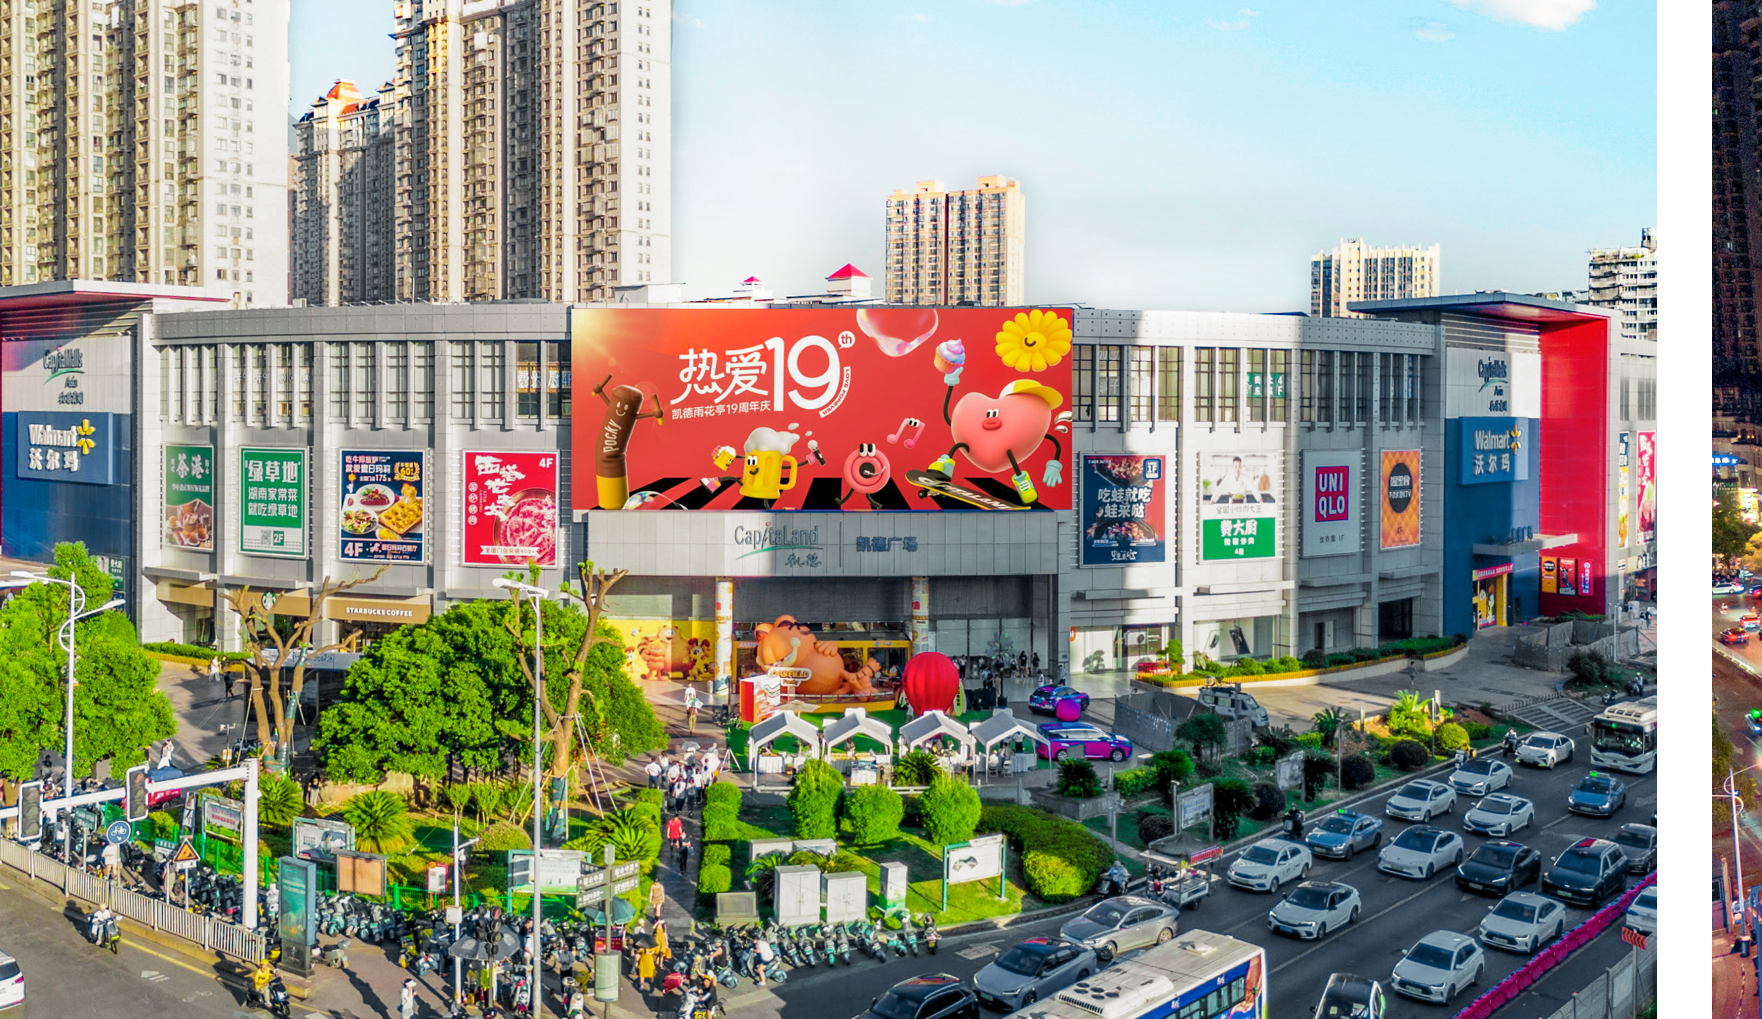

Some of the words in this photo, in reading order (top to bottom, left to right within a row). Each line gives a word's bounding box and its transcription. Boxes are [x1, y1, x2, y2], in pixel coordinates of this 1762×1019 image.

[672, 400, 772, 420] 凯德雨花亭19周年庆
[822, 390, 846, 416] FOREVER
[29, 424, 78, 446] Walmart
[603, 419, 622, 452] POCKY
[1475, 430, 1510, 450] Walmart
[29, 448, 78, 471] 沃尔玛
[539, 458, 553, 468] 4F
[1474, 453, 1510, 475] 沃尔玛
[248, 460, 298, 483] 绿草地
[1147, 464, 1157, 474] 1F
[1319, 473, 1343, 492] UNI
[248, 487, 298, 502] 湖南家常菜
[1098, 487, 1152, 503] 吃蛙就吃
[248, 503, 298, 518] 就吃绿草地
[1104, 503, 1146, 518] 蛙来哒
[1216, 505, 1262, 514] 全国小炒肉大王
[1318, 496, 1345, 518] QLO
[734, 522, 818, 550] CapitaLand
[1220, 519, 1258, 537] 费大厨
[273, 533, 284, 543] 2F
[856, 536, 918, 552] 凯德广场
[344, 542, 363, 556] 4F
[346, 607, 385, 616] STARBUCKS
